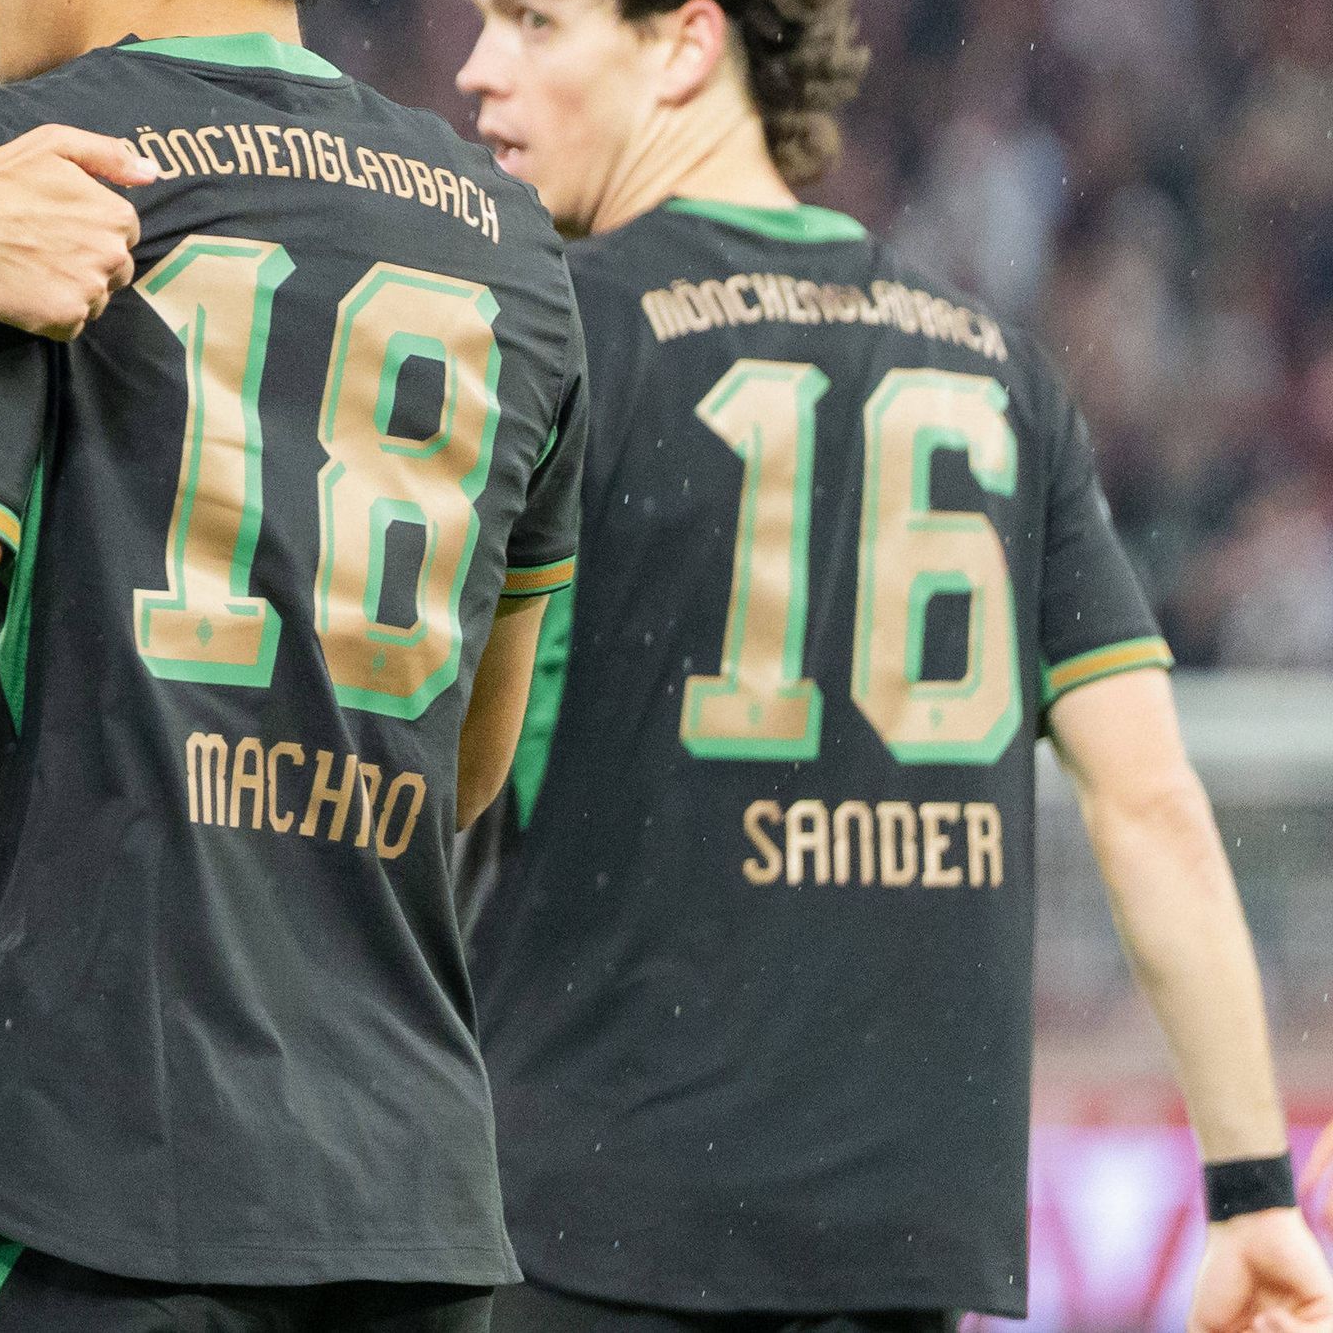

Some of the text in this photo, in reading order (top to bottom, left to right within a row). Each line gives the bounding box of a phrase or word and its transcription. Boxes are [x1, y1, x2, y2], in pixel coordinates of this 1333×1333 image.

[123, 124, 500, 244] ÖNCHENGLADBACH
[132, 234, 501, 720] 18
[679, 358, 1022, 765] 16
[741, 798, 1004, 889] SANDER
